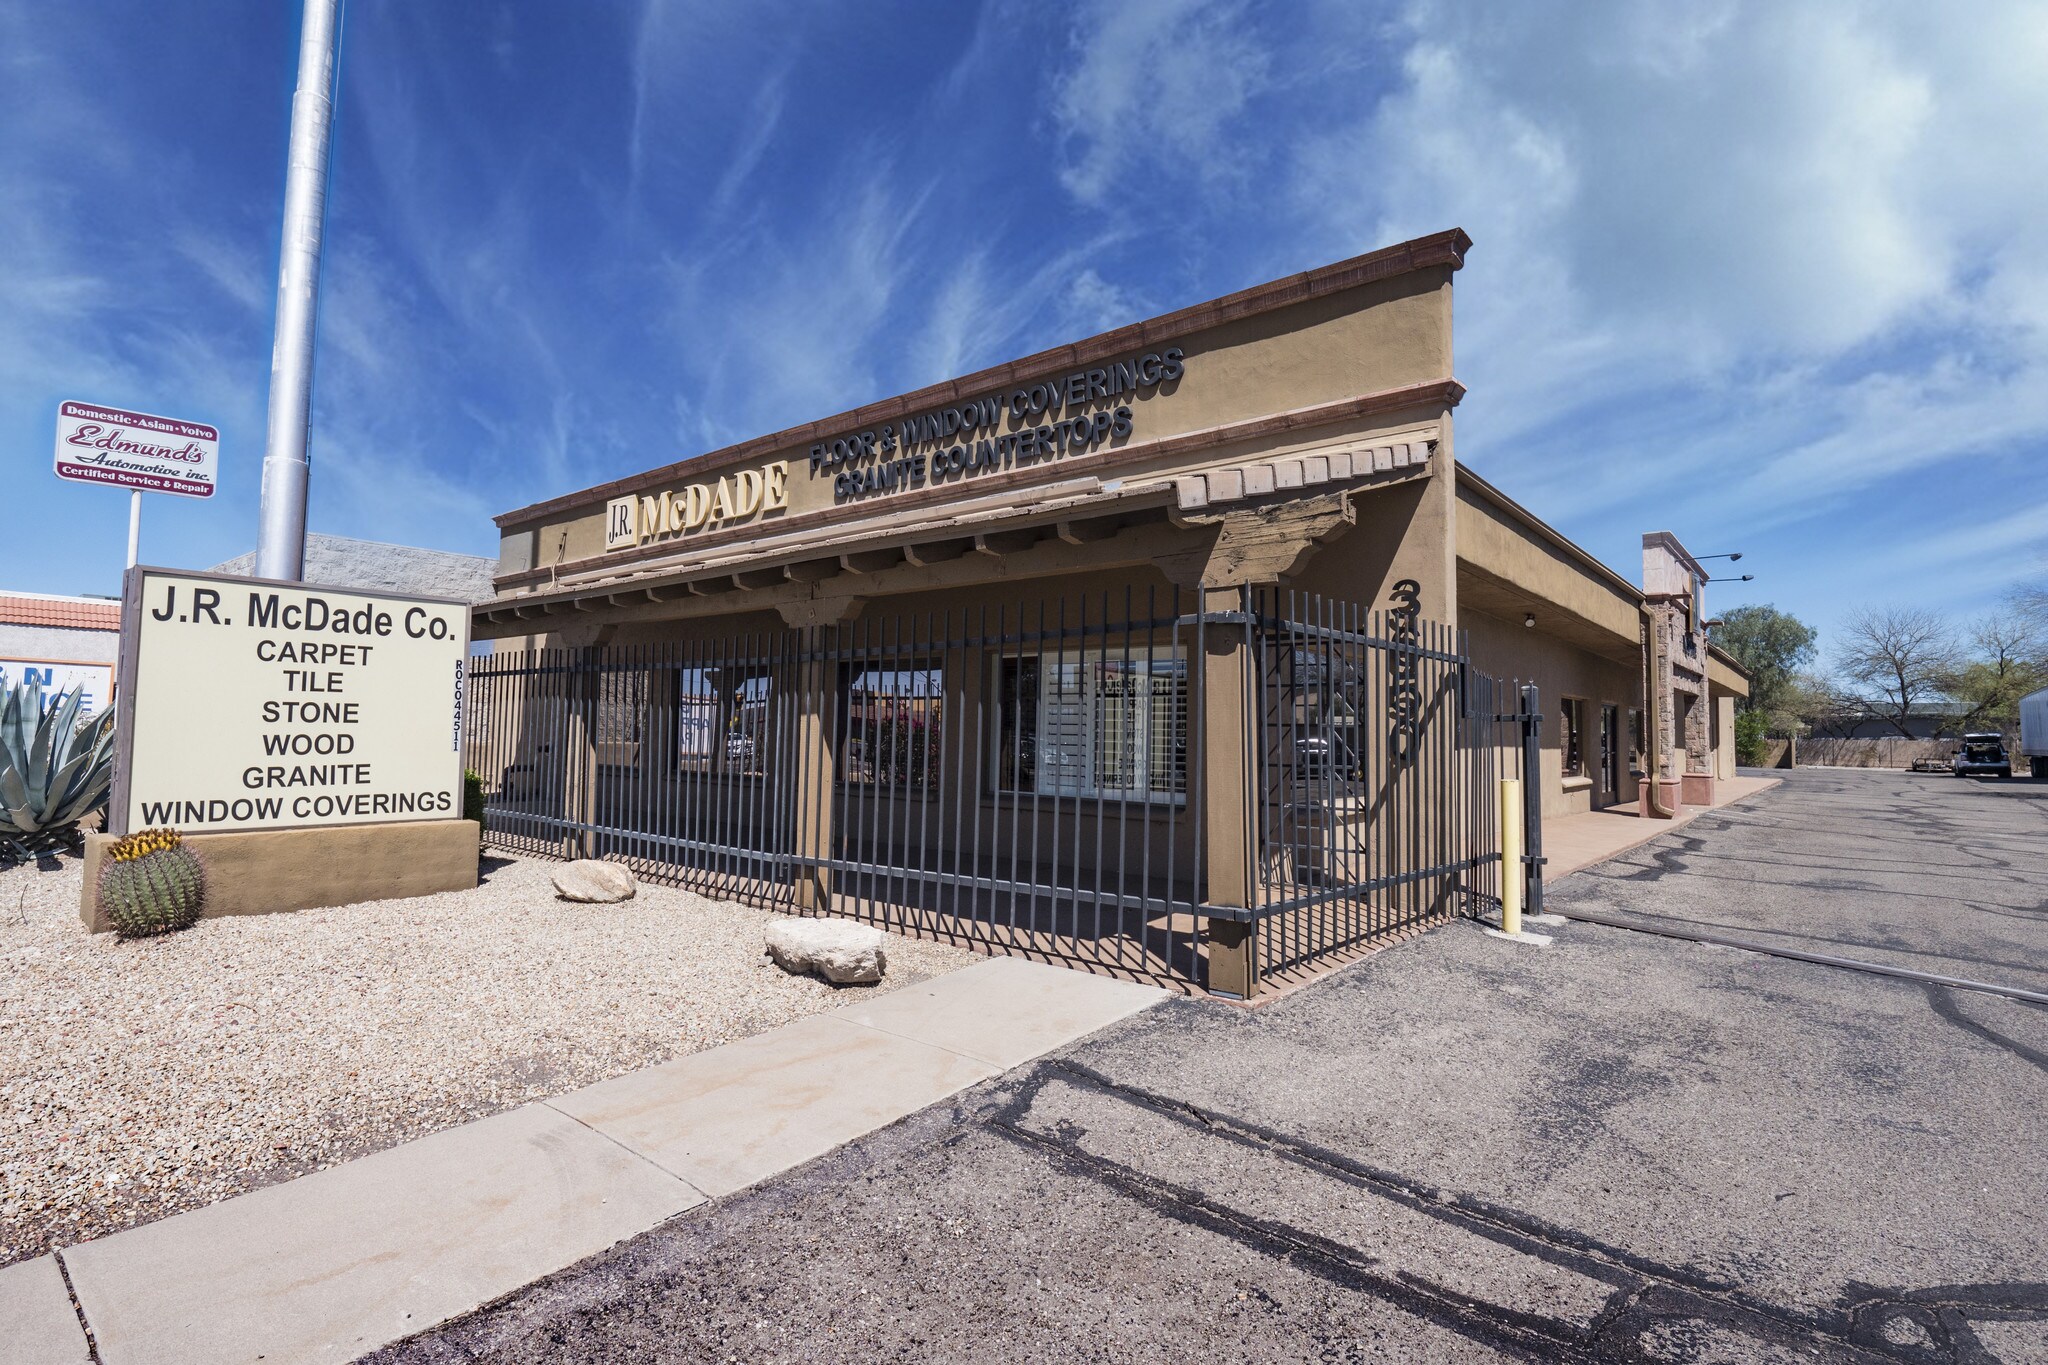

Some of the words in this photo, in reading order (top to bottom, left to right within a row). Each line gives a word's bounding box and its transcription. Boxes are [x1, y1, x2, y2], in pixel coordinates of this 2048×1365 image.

[67, 405, 131, 425] Domestic
[138, 418, 174, 432] Asian
[180, 425, 213, 439] Volvo
[810, 430, 877, 471] FLOOR
[880, 425, 897, 452] &
[900, 395, 1003, 447] WINDOW
[1008, 347, 1184, 419] COVERINGS
[66, 423, 208, 464] Edmund's
[834, 454, 926, 497] GRANITE
[931, 406, 1134, 478] COUNTERTOPS
[62, 466, 116, 481] Certified
[118, 473, 161, 487] Service
[163, 480, 171, 488] &
[173, 481, 210, 494] Repair
[75, 452, 180, 477] Automotive
[185, 469, 210, 482] inc.
[608, 504, 632, 544] J.R.
[640, 460, 789, 538] McDADE
[151, 585, 231, 626] J.R.
[247, 592, 393, 636] McDade
[404, 607, 456, 641] Co.
[256, 639, 374, 666] CARPET
[282, 670, 344, 693] TILE
[261, 701, 360, 724] STONE
[262, 733, 355, 756] WOOD
[242, 763, 371, 789] GRANITE
[141, 797, 284, 826] WINDOW
[292, 791, 452, 818] COVERINGS
